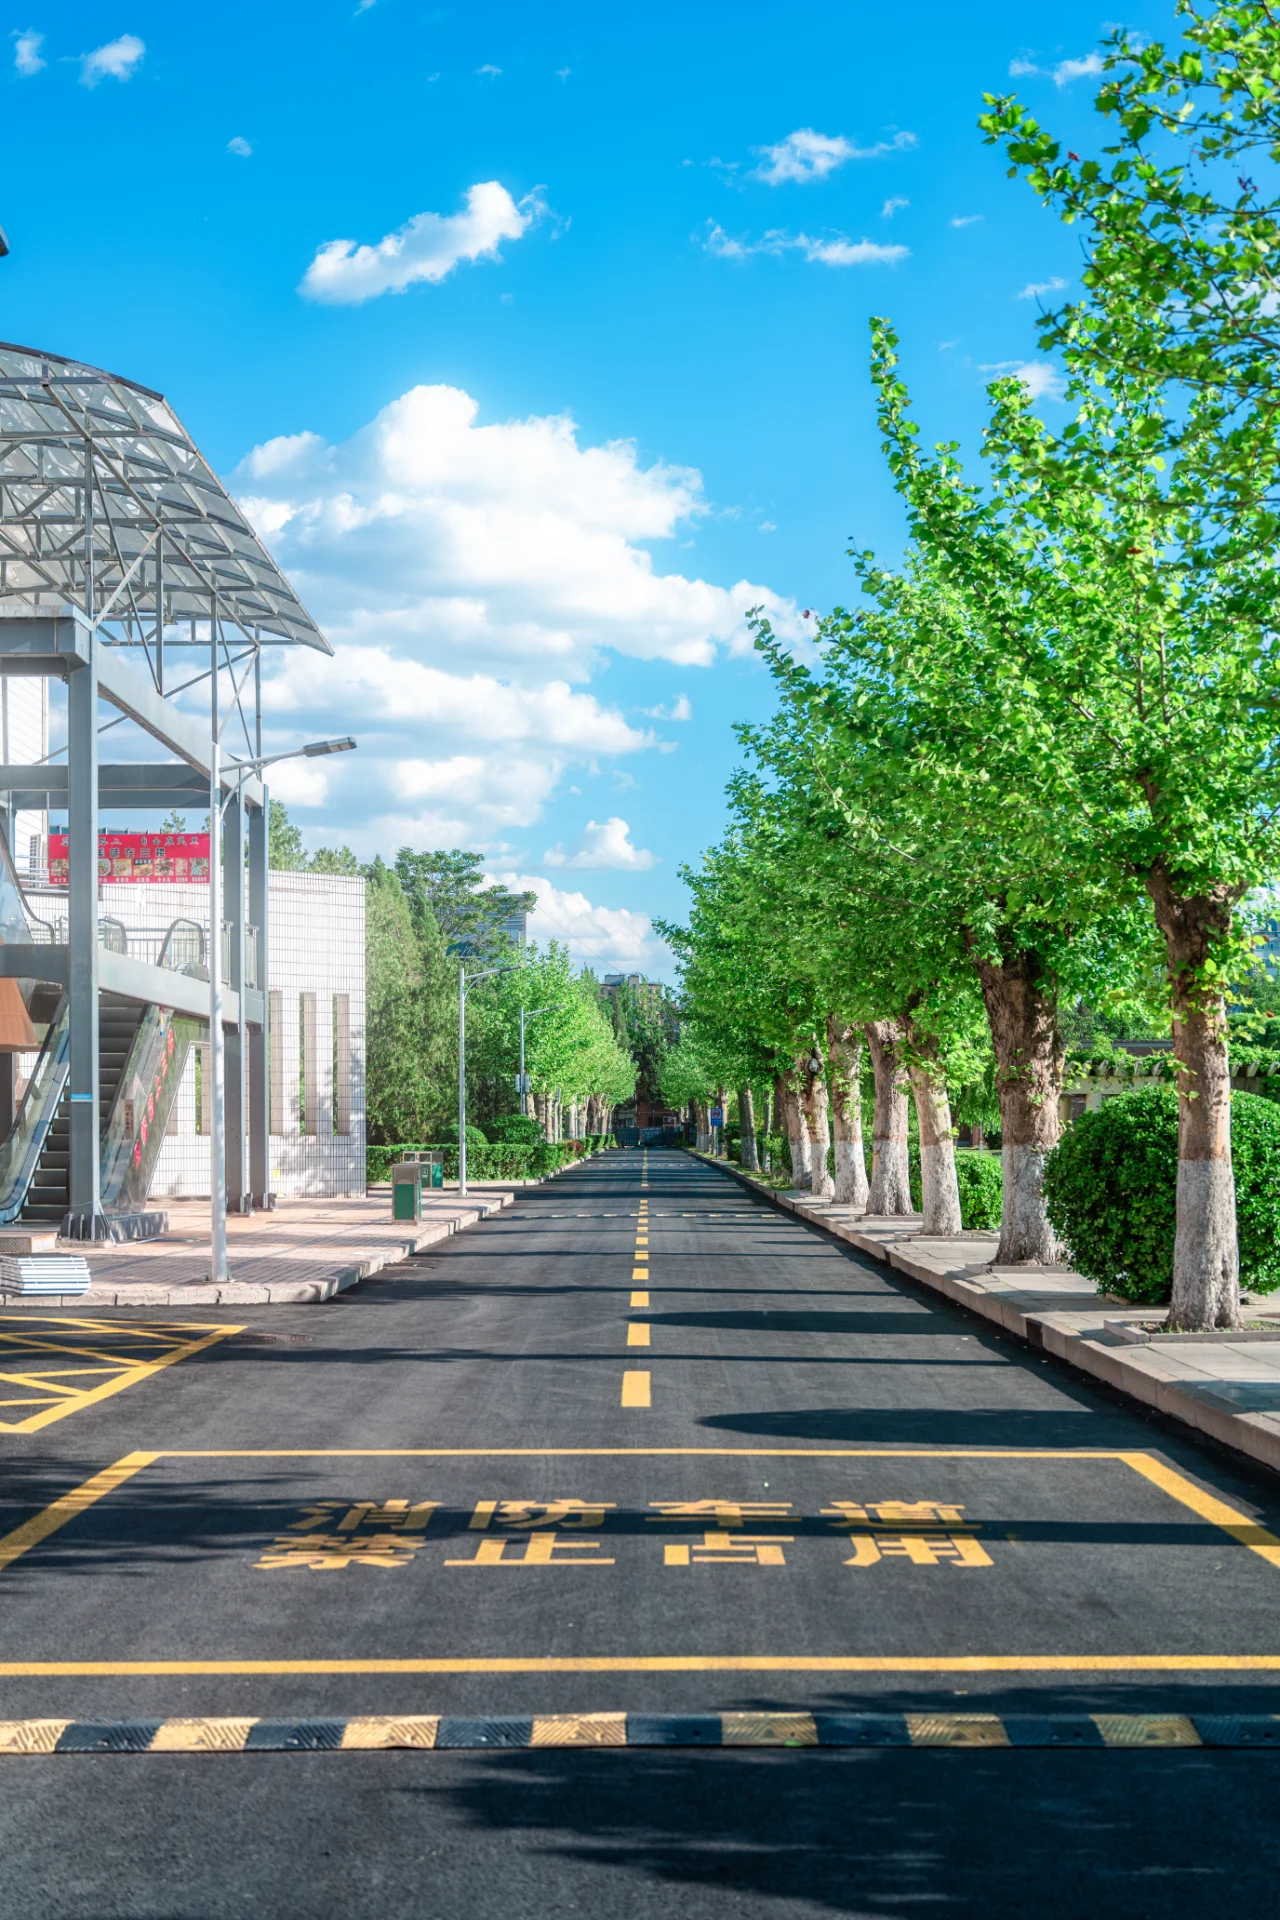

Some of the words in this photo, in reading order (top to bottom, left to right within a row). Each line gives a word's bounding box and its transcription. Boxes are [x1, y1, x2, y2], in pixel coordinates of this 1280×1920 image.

[287, 1499, 982, 1530] 消防车道
[252, 1531, 994, 1569] 禁止占用
